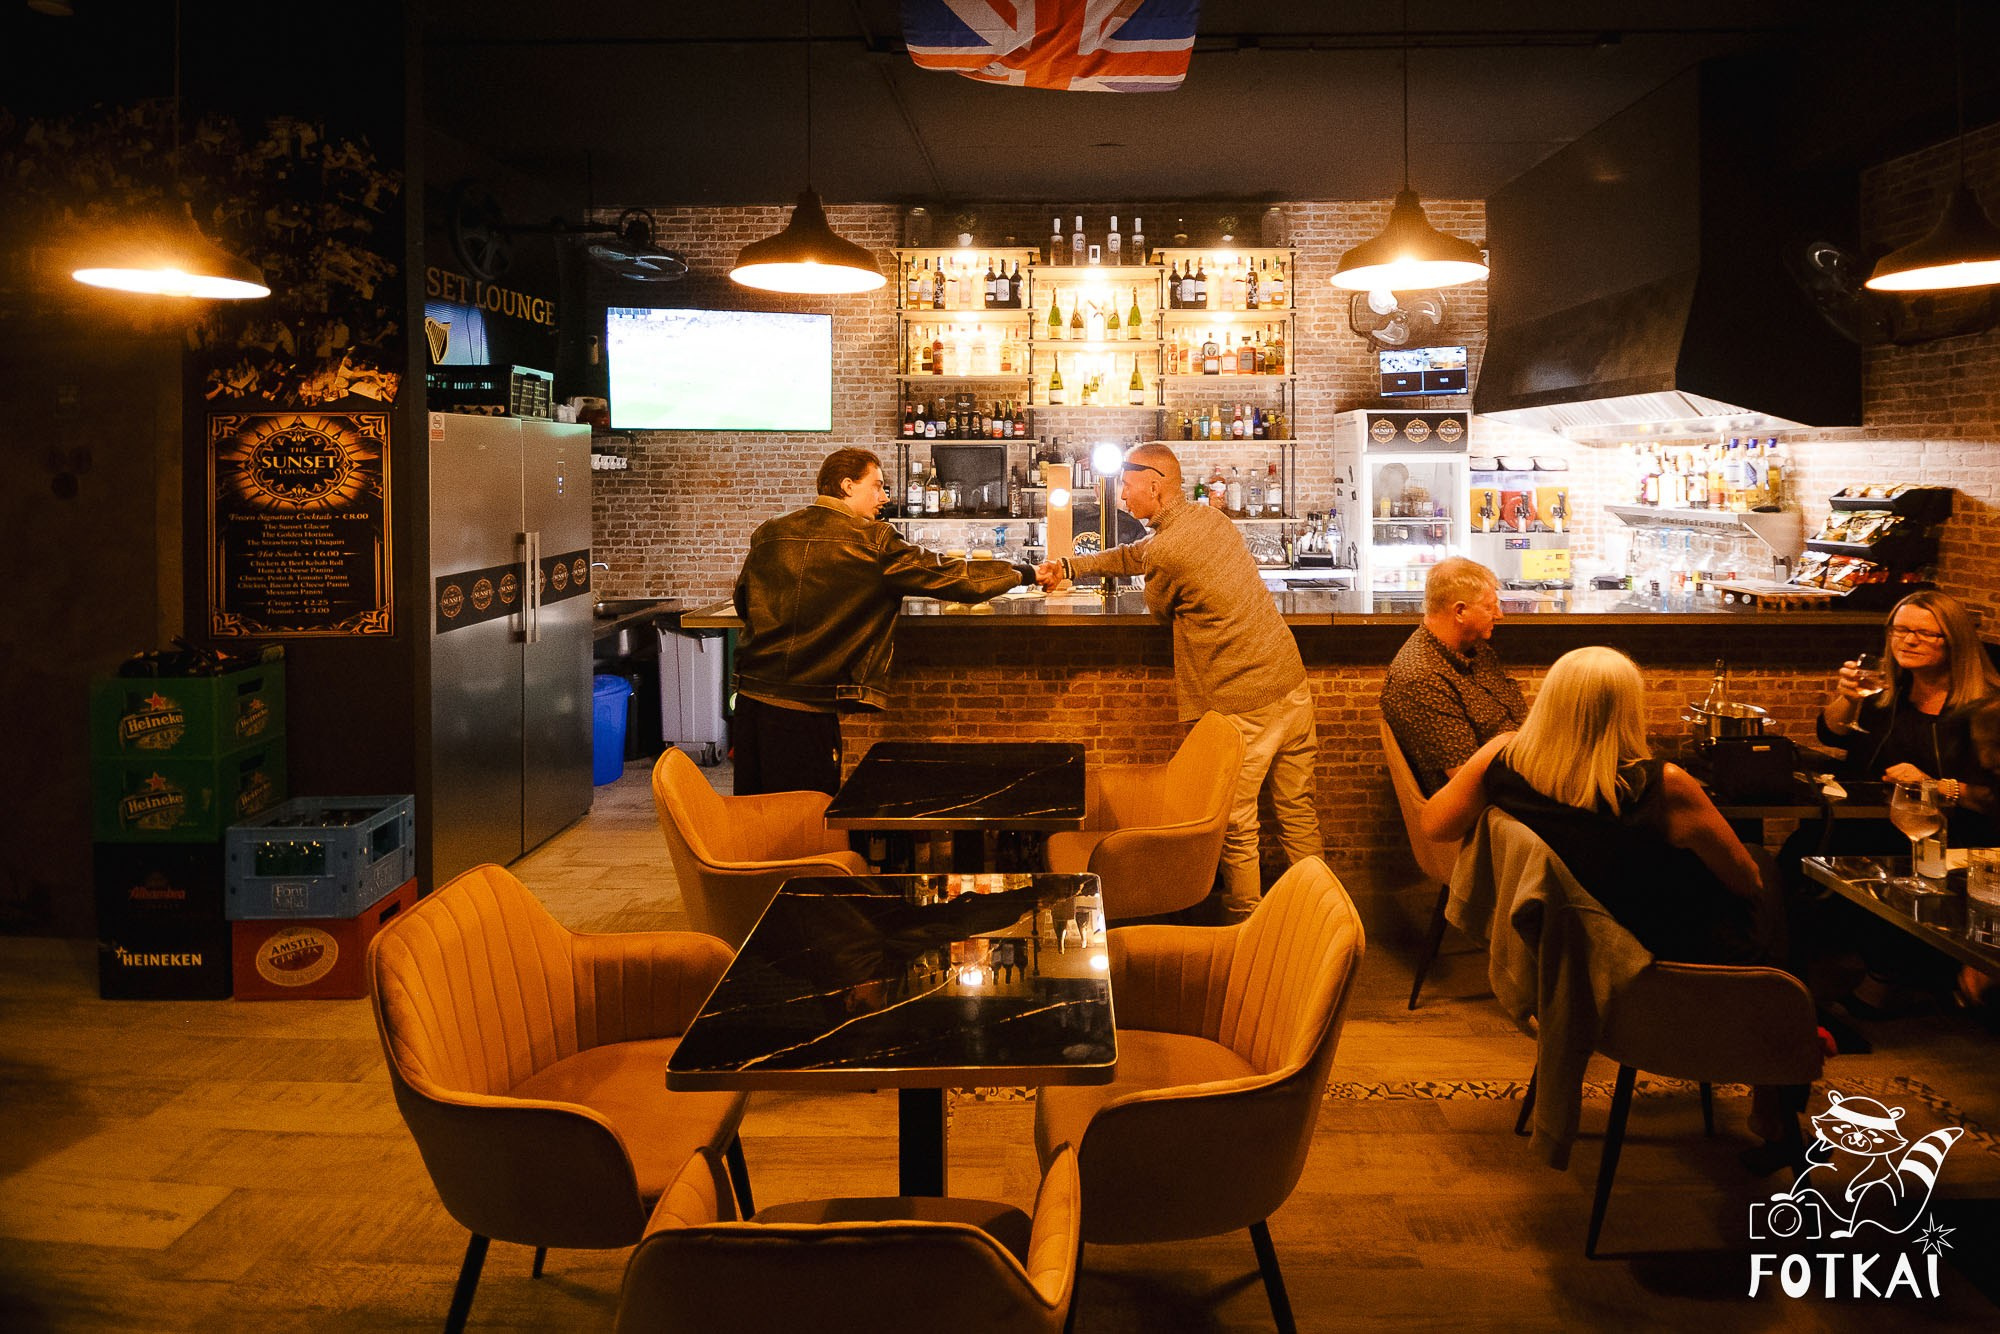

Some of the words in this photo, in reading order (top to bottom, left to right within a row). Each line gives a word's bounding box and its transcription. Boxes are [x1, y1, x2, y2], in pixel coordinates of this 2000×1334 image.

[475, 281, 556, 326] LOUNGE
[261, 455, 338, 469] SUNSET
[296, 512, 332, 521] Cocktails
[275, 885, 303, 897] Font
[271, 937, 318, 955] AMSTEL
[122, 952, 203, 967] HEINEKEN
